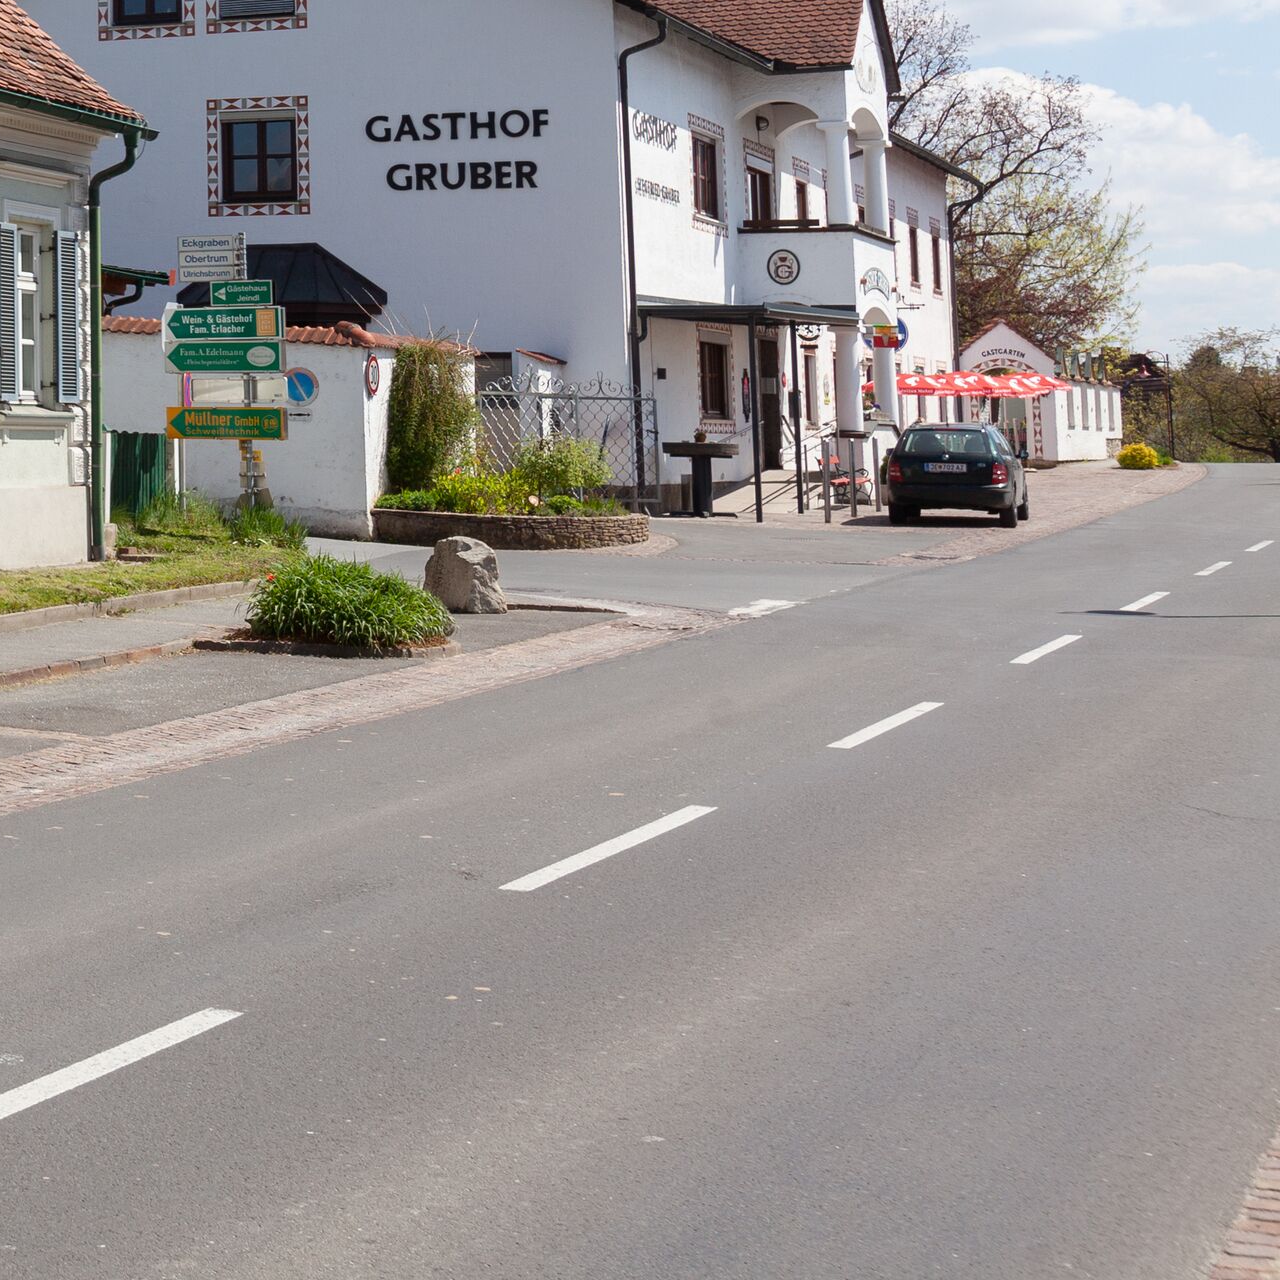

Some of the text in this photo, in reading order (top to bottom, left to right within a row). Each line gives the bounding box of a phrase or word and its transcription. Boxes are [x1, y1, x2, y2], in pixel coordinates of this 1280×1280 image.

[365, 108, 549, 143] GASTHOF
[386, 160, 538, 191] GRUBER
[182, 238, 230, 248] Eckgraben
[184, 255, 228, 263] Obertrum
[183, 269, 231, 278] Ulrichsbrunn
[227, 284, 267, 292] Gästehaus
[237, 294, 260, 302] Jeindl
[181, 315, 205, 324] Wein-
[207, 314, 214, 323] &
[216, 313, 253, 323] Gästehof
[190, 324, 245, 334] Fam. Erlacher
[185, 411, 231, 426] Müllner
[235, 416, 260, 425] GmbH
[186, 427, 260, 435] Schweißtechnik
